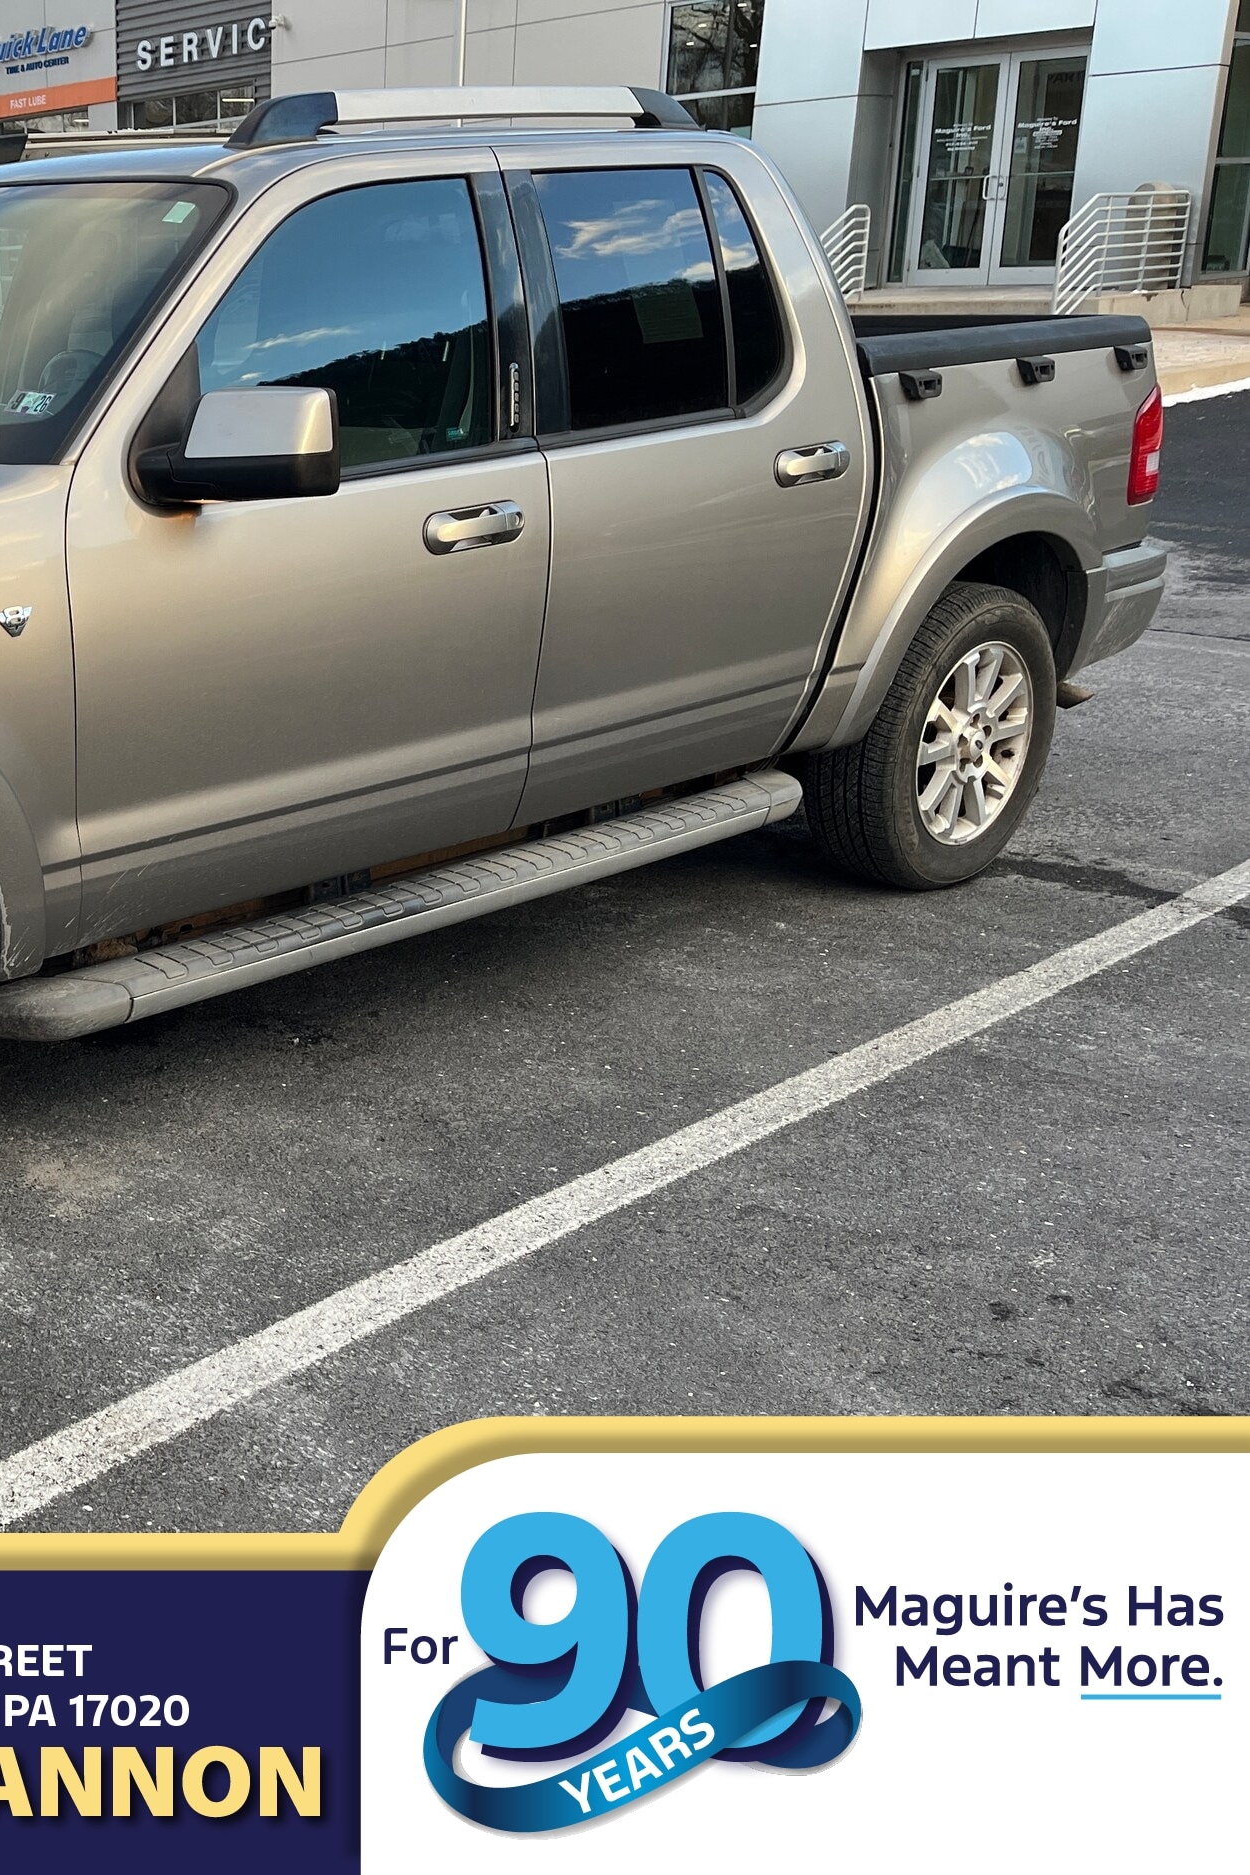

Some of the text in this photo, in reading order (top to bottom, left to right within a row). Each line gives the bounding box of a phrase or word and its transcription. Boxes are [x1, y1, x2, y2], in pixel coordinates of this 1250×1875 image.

[37, 25, 89, 55] Lane
[25, 61, 43, 71] AUTO
[43, 56, 70, 68] CENTER
[10, 94, 47, 109] FAST LUBE
[973, 123, 992, 131] Ford
[1058, 118, 1078, 126] Ford
